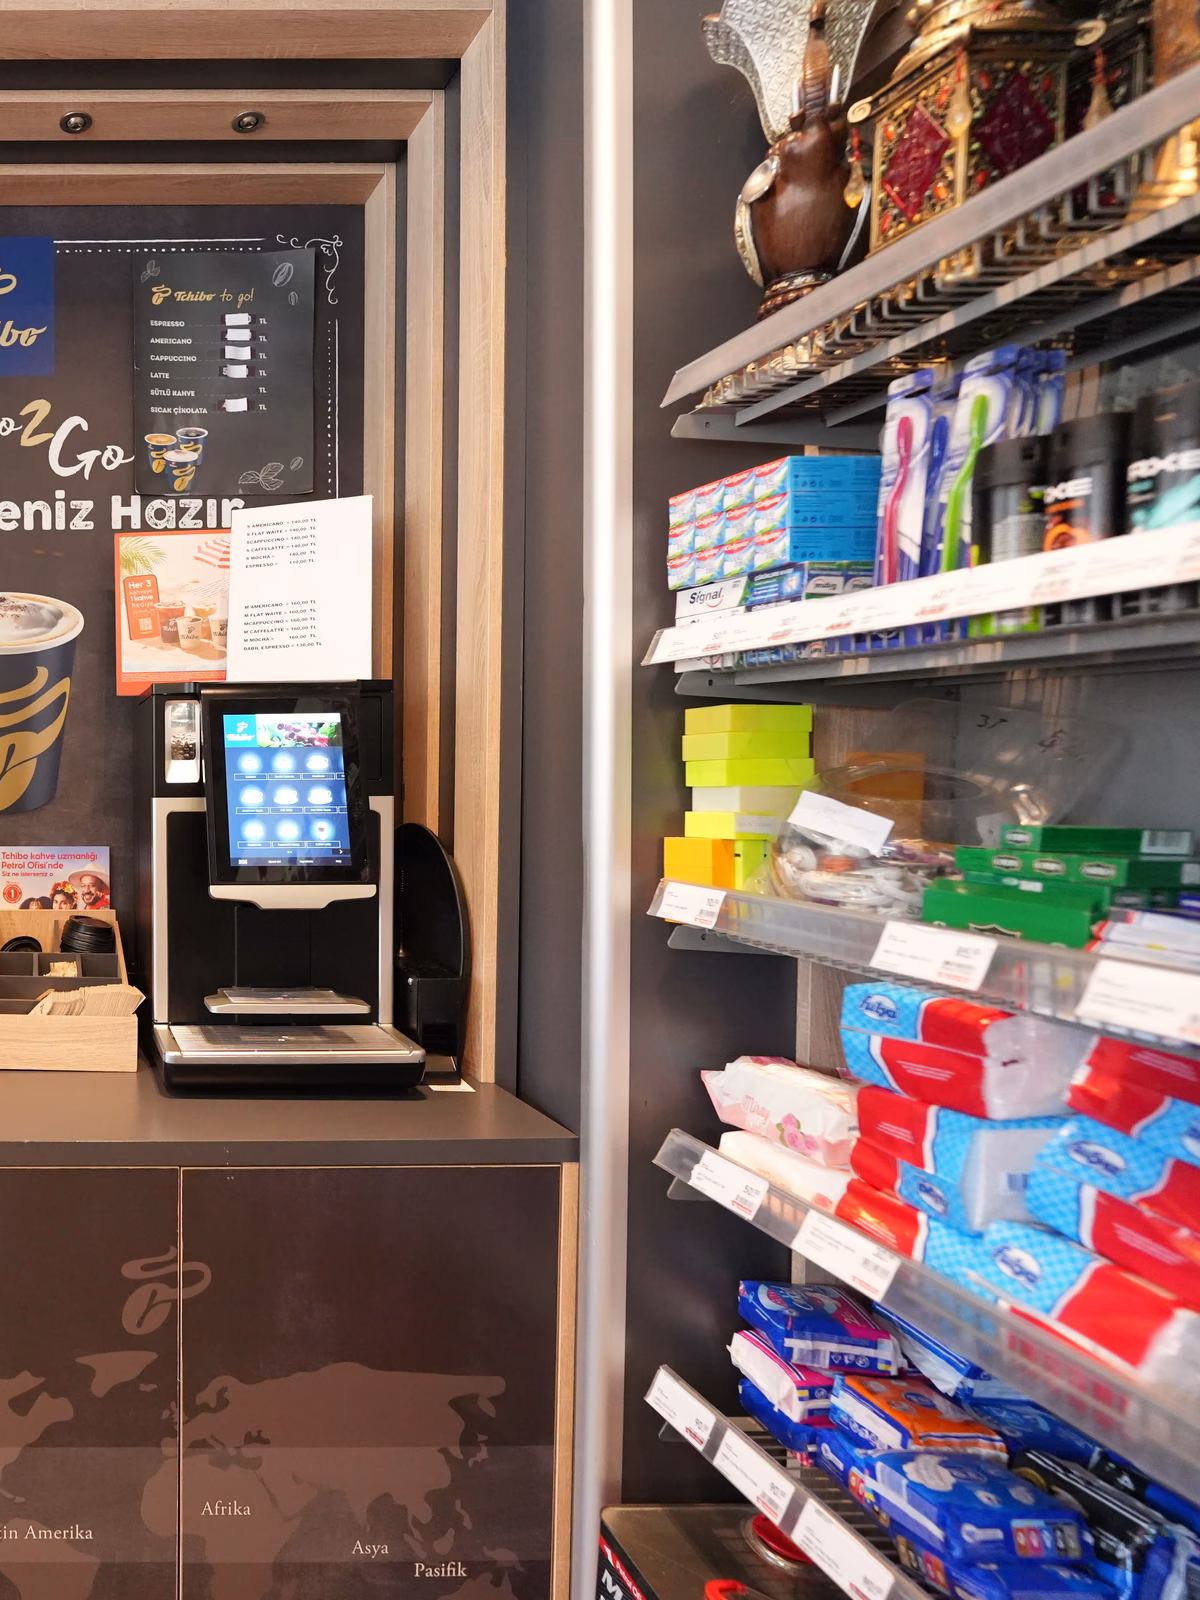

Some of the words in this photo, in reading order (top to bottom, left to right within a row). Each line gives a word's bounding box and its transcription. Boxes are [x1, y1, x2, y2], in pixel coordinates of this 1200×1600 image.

[174, 291, 216, 302] Tchibo
[220, 288, 233, 302] to
[237, 288, 255, 309] go!
[150, 388, 171, 397] SÜTLÜ
[173, 406, 208, 415] ÇİKOLATA
[49, 415, 136, 480] Go
[111, 494, 246, 530] Hazır
[128, 581, 143, 589] Her
[689, 587, 723, 604] Signal
[1, 851, 29, 860] Tchibo
[30, 851, 56, 860] kahve
[57, 851, 98, 862] uzmanlığı
[1, 861, 26, 870] Petrol
[27, 861, 64, 870] Ofisi'nde
[201, 1500, 252, 1516] Afrika
[24, 1524, 94, 1541] Amerika
[351, 1540, 390, 1559] Asya
[414, 1562, 468, 1578] Pasifik
